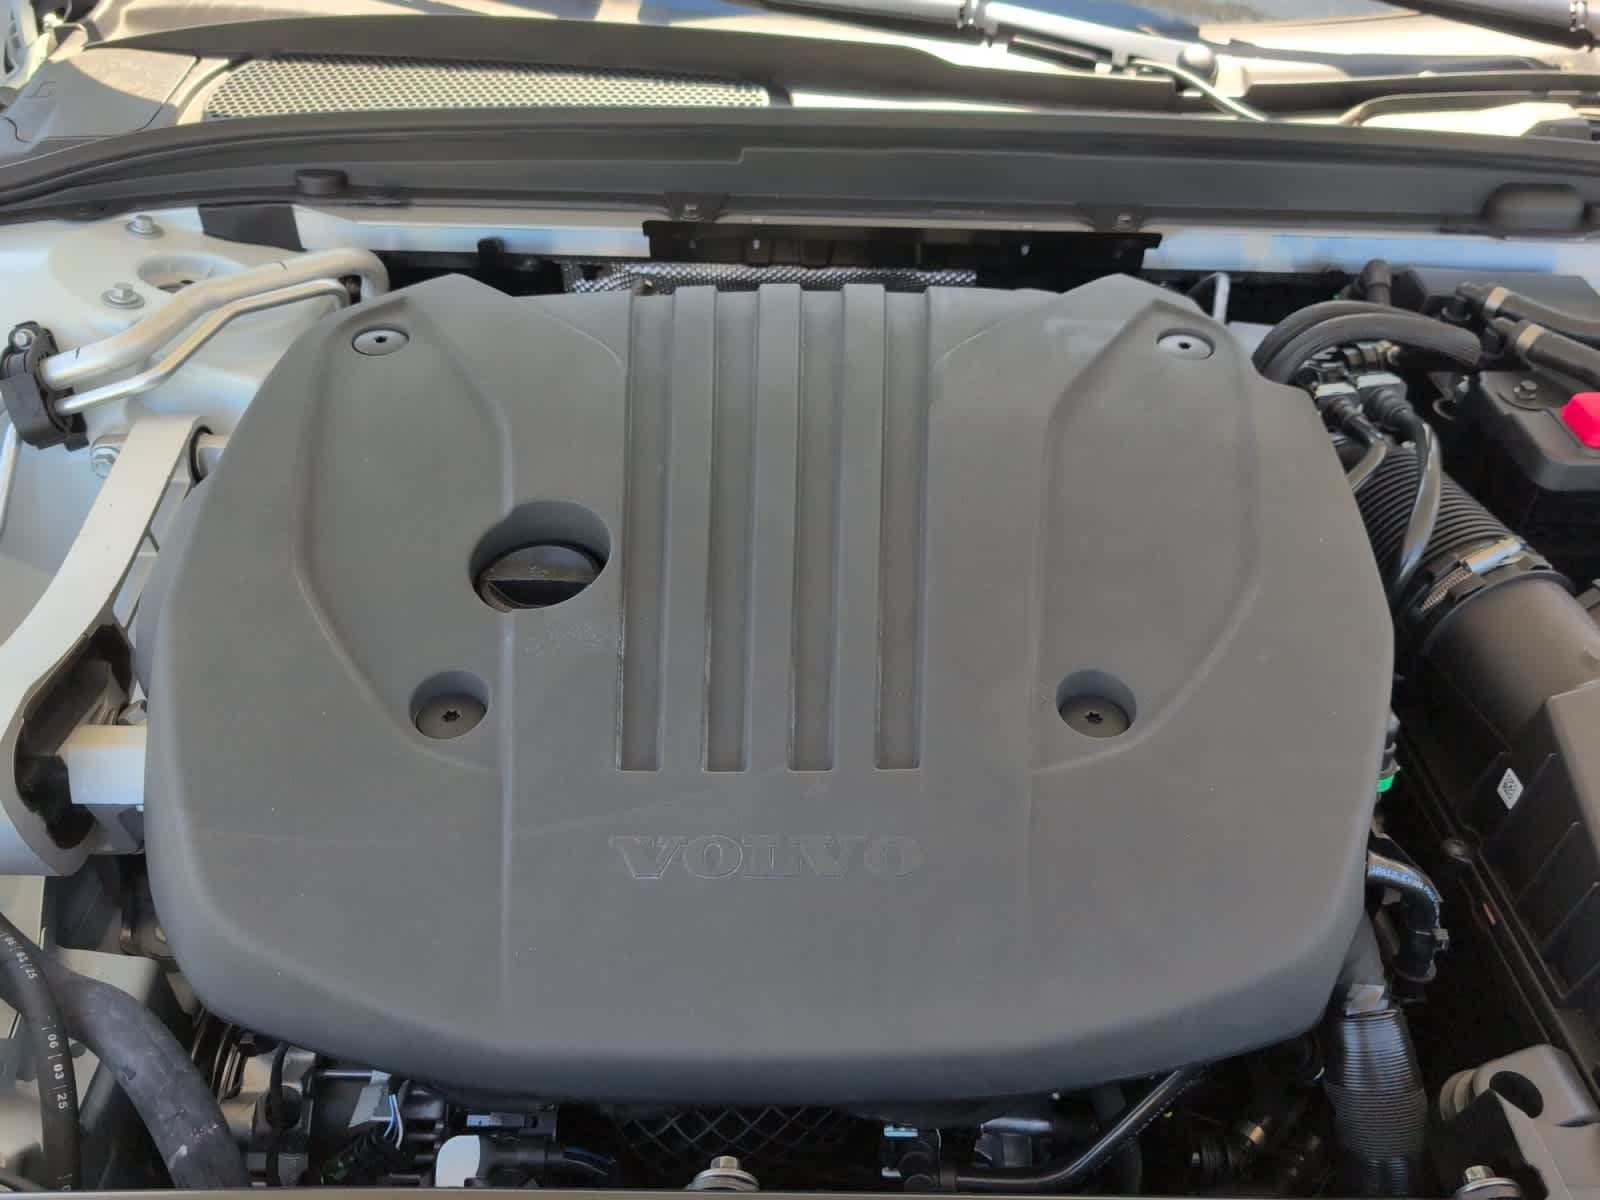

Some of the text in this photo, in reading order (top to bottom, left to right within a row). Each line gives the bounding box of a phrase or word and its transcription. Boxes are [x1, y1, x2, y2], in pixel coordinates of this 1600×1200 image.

[608, 833, 924, 880] VOLVO
[47, 1033, 69, 1110] 06 03 25
